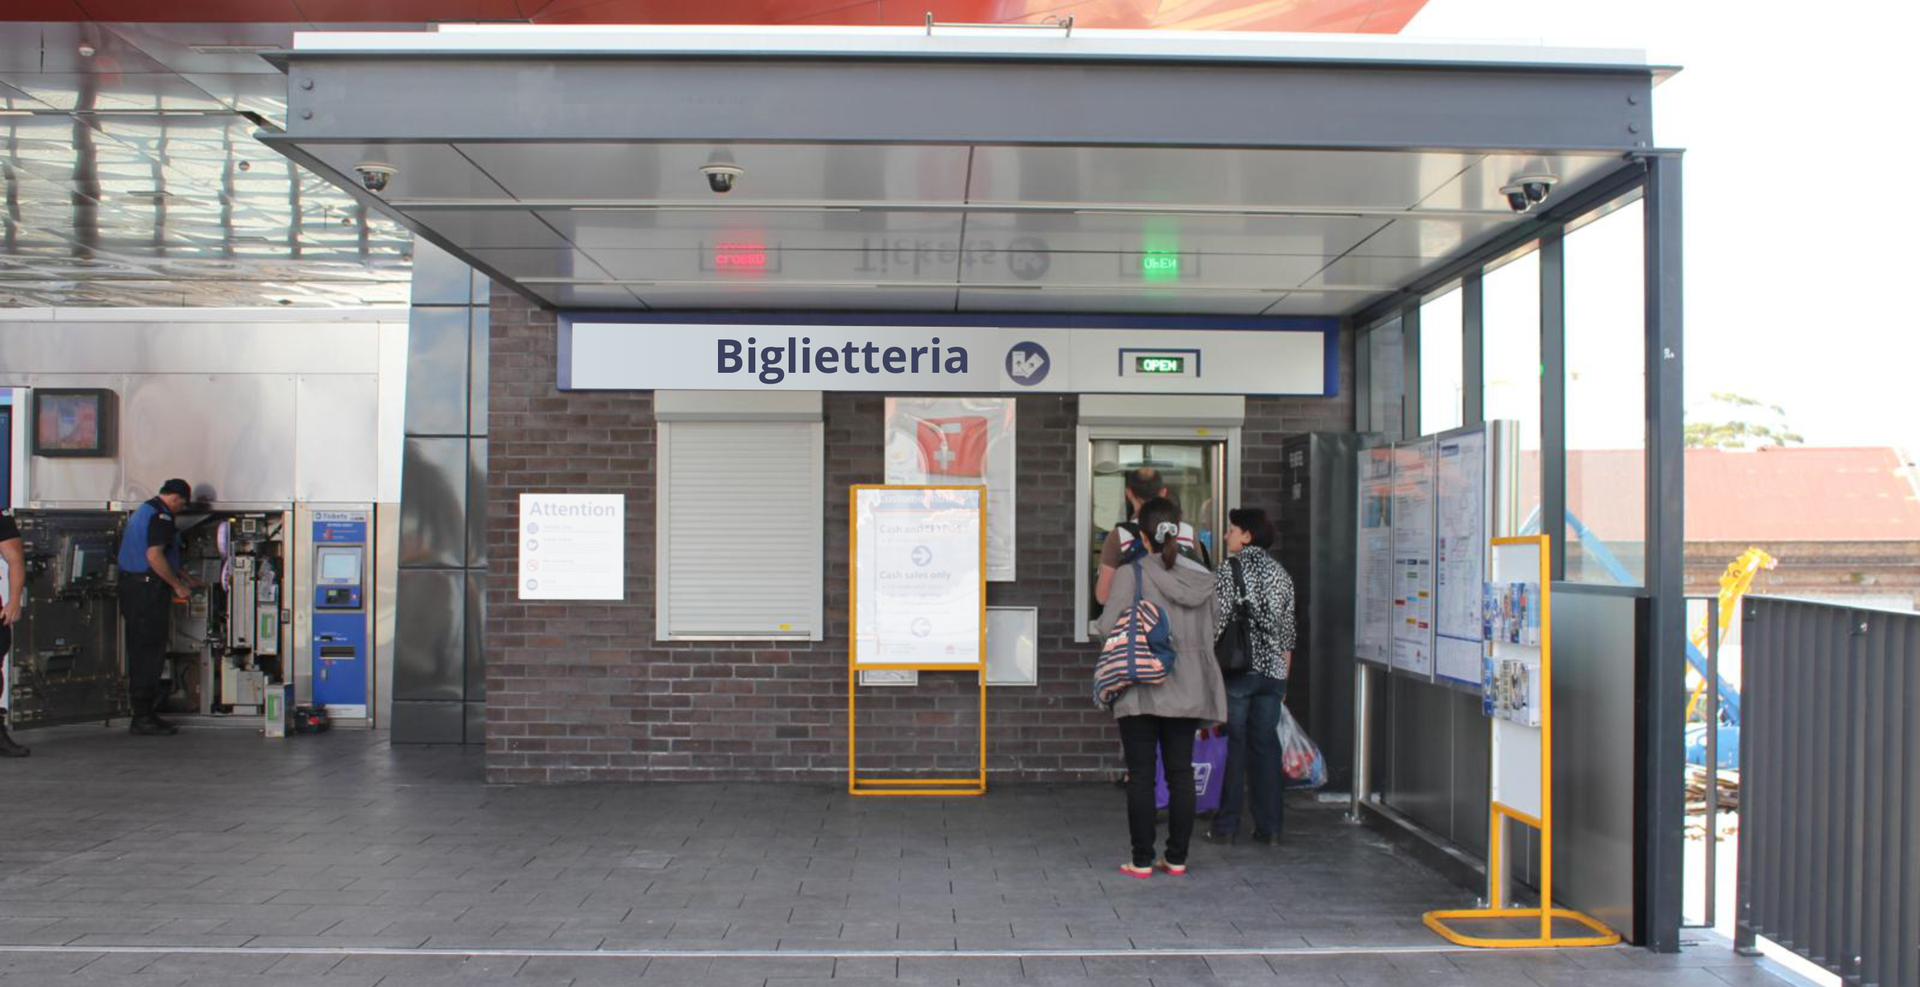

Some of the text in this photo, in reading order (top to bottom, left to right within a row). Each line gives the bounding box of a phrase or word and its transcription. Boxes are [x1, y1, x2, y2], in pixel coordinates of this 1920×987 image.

[717, 337, 968, 384] Biglietteria
[1143, 358, 1178, 372] OPEN
[530, 502, 615, 517] Attention
[879, 524, 903, 533] Cash
[879, 570, 951, 582] Cash sales only
